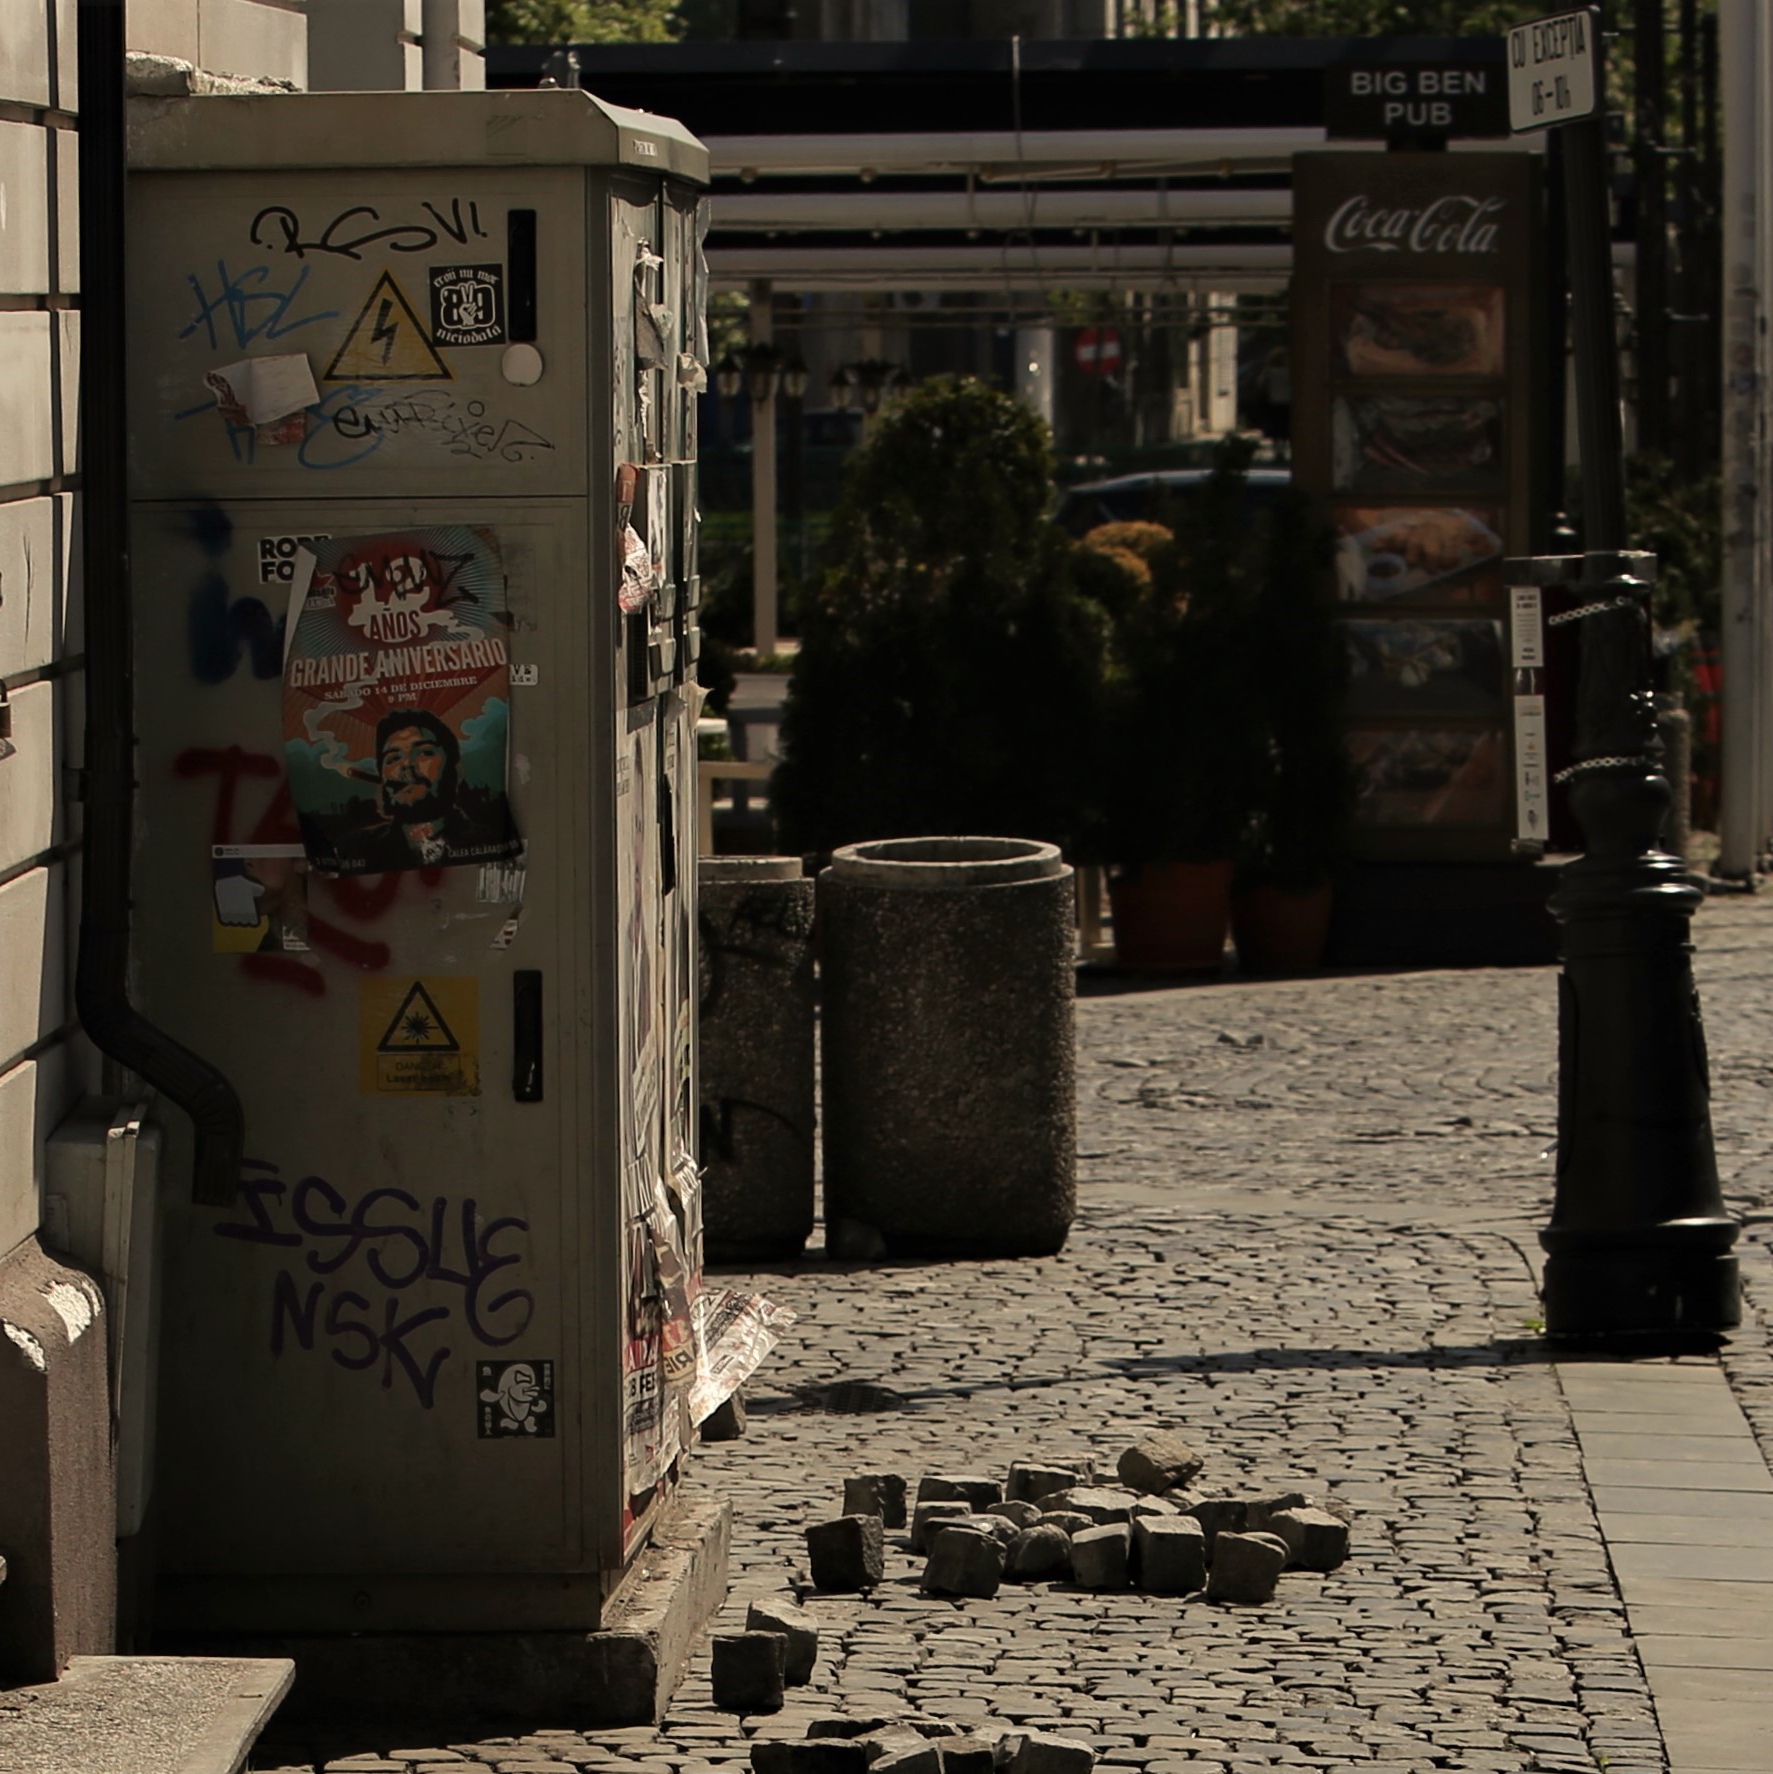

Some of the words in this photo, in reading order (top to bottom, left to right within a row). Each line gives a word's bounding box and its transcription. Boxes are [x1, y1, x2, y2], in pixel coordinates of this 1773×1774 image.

[1351, 71, 1408, 95] BIG
[1418, 71, 1487, 94] BEN
[1384, 102, 1453, 126] PUB
[370, 606, 422, 641] AÑOS
[290, 652, 373, 689] GRANDE
[376, 637, 508, 680] ANIVERSARIO
[410, 676, 477, 691] DICIEMBRE
